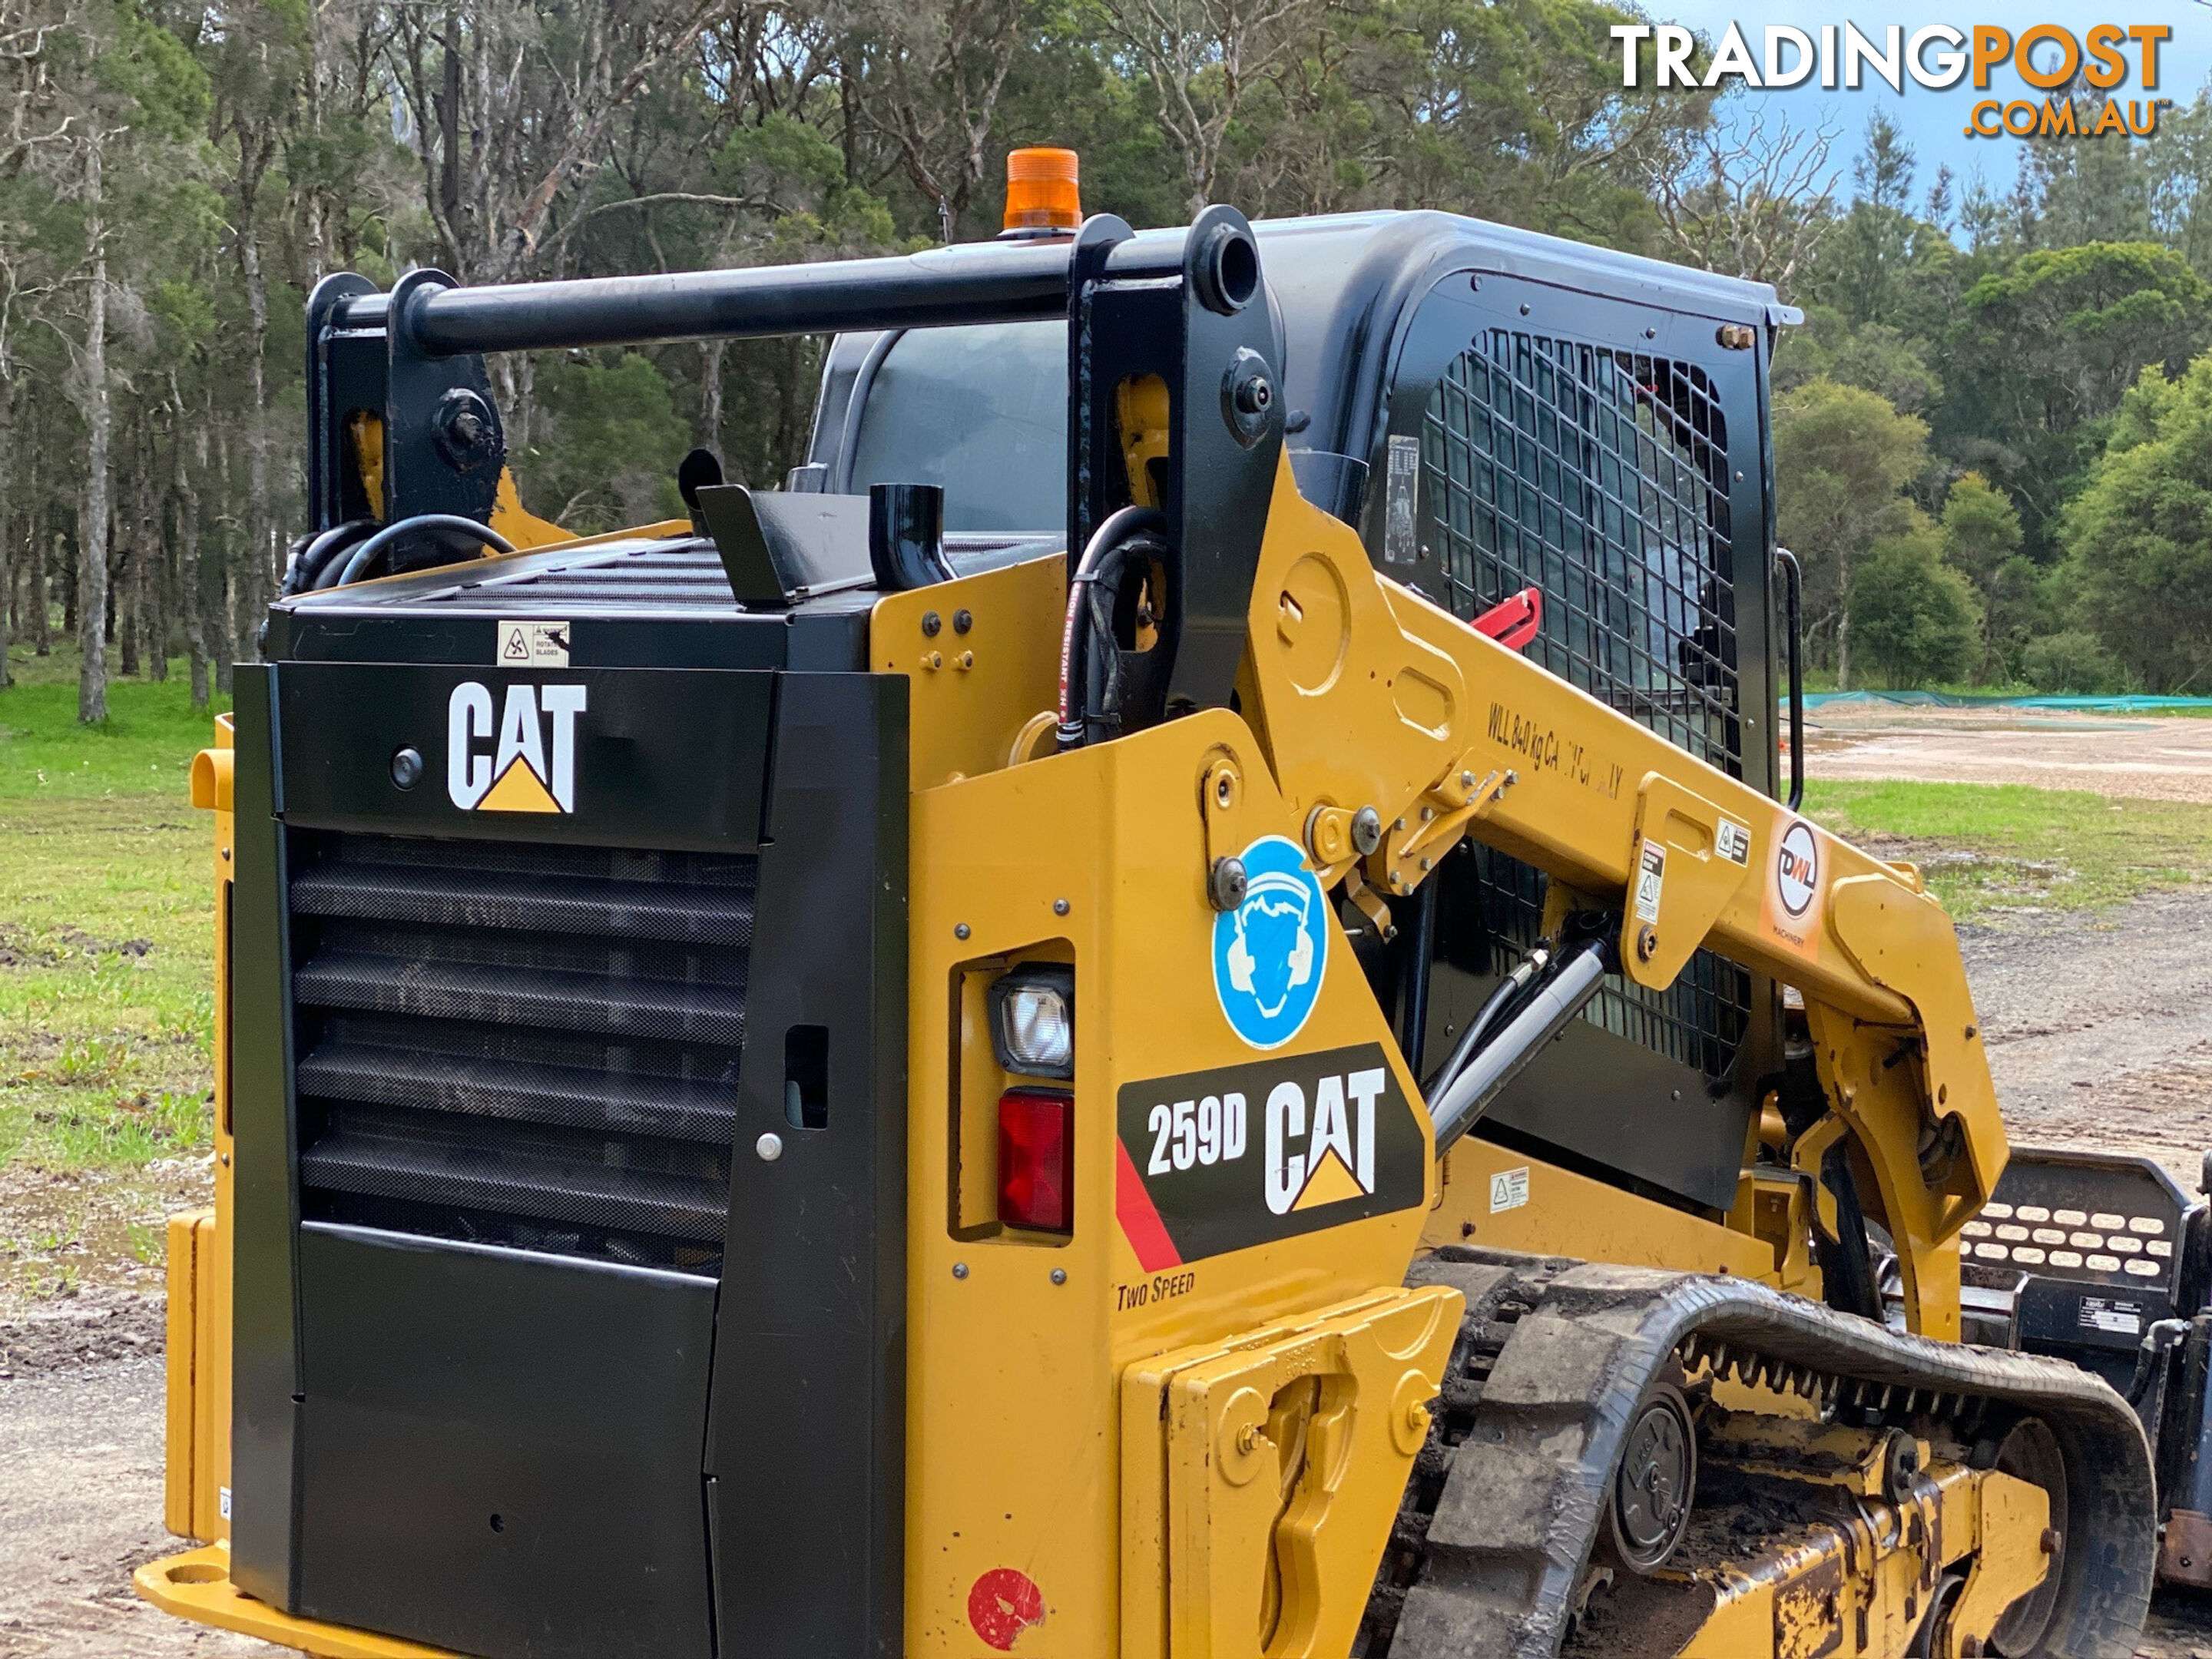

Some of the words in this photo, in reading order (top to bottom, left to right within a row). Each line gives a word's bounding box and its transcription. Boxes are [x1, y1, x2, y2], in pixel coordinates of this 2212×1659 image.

[1061, 621, 1073, 682] RESISTANT
[448, 681, 587, 813] CAT
[1488, 700, 1509, 746] WLL
[1781, 846, 1816, 890] DWL
[1773, 924, 1805, 949] MACHINERY
[1147, 1093, 1247, 1176] 259D
[1264, 1068, 1386, 1215] CAT
